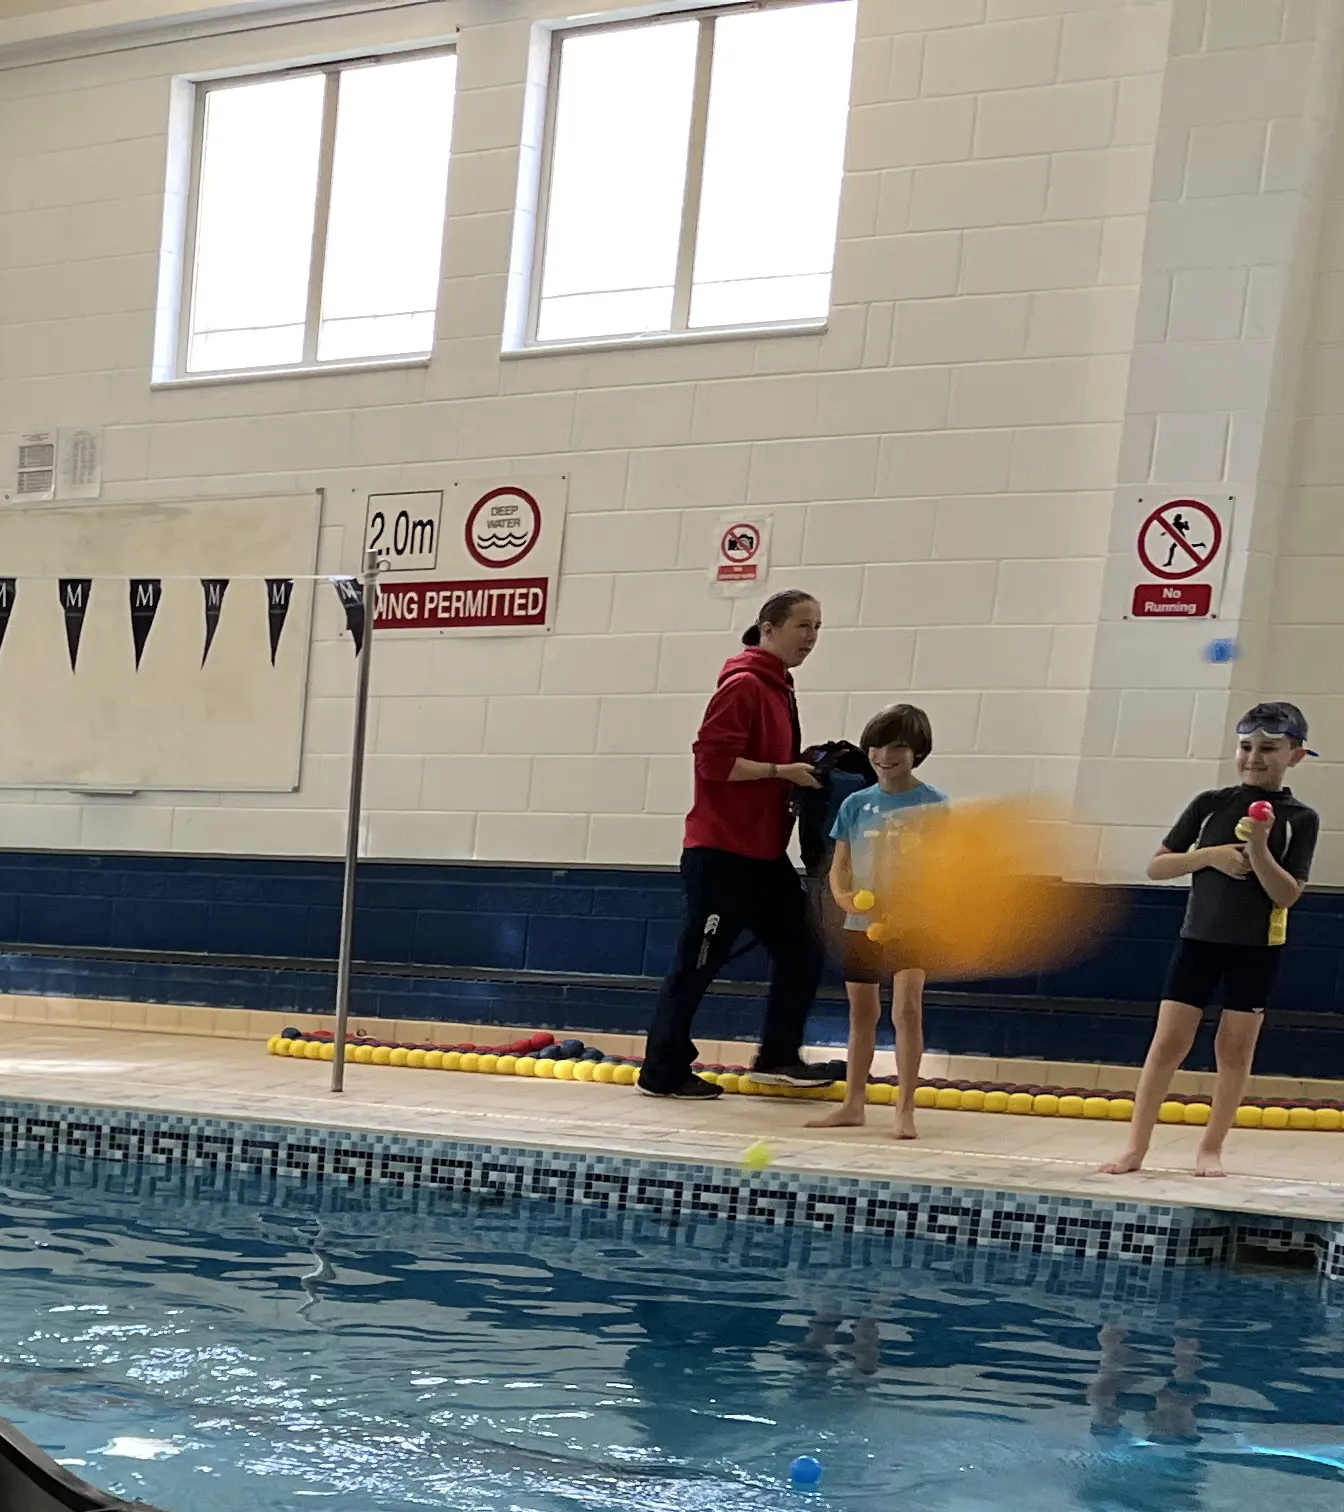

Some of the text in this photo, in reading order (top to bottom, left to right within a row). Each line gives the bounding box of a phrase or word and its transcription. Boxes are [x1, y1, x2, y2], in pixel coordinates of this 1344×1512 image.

[490, 505, 519, 516] DEEP
[369, 510, 434, 556] 2.0m
[486, 518, 521, 529] WATER
[66, 583, 82, 608] M
[136, 583, 153, 607] M
[272, 583, 285, 605] M
[424, 587, 543, 619] PERMITTED
[1162, 587, 1182, 599] No
[1144, 601, 1197, 614] Running
